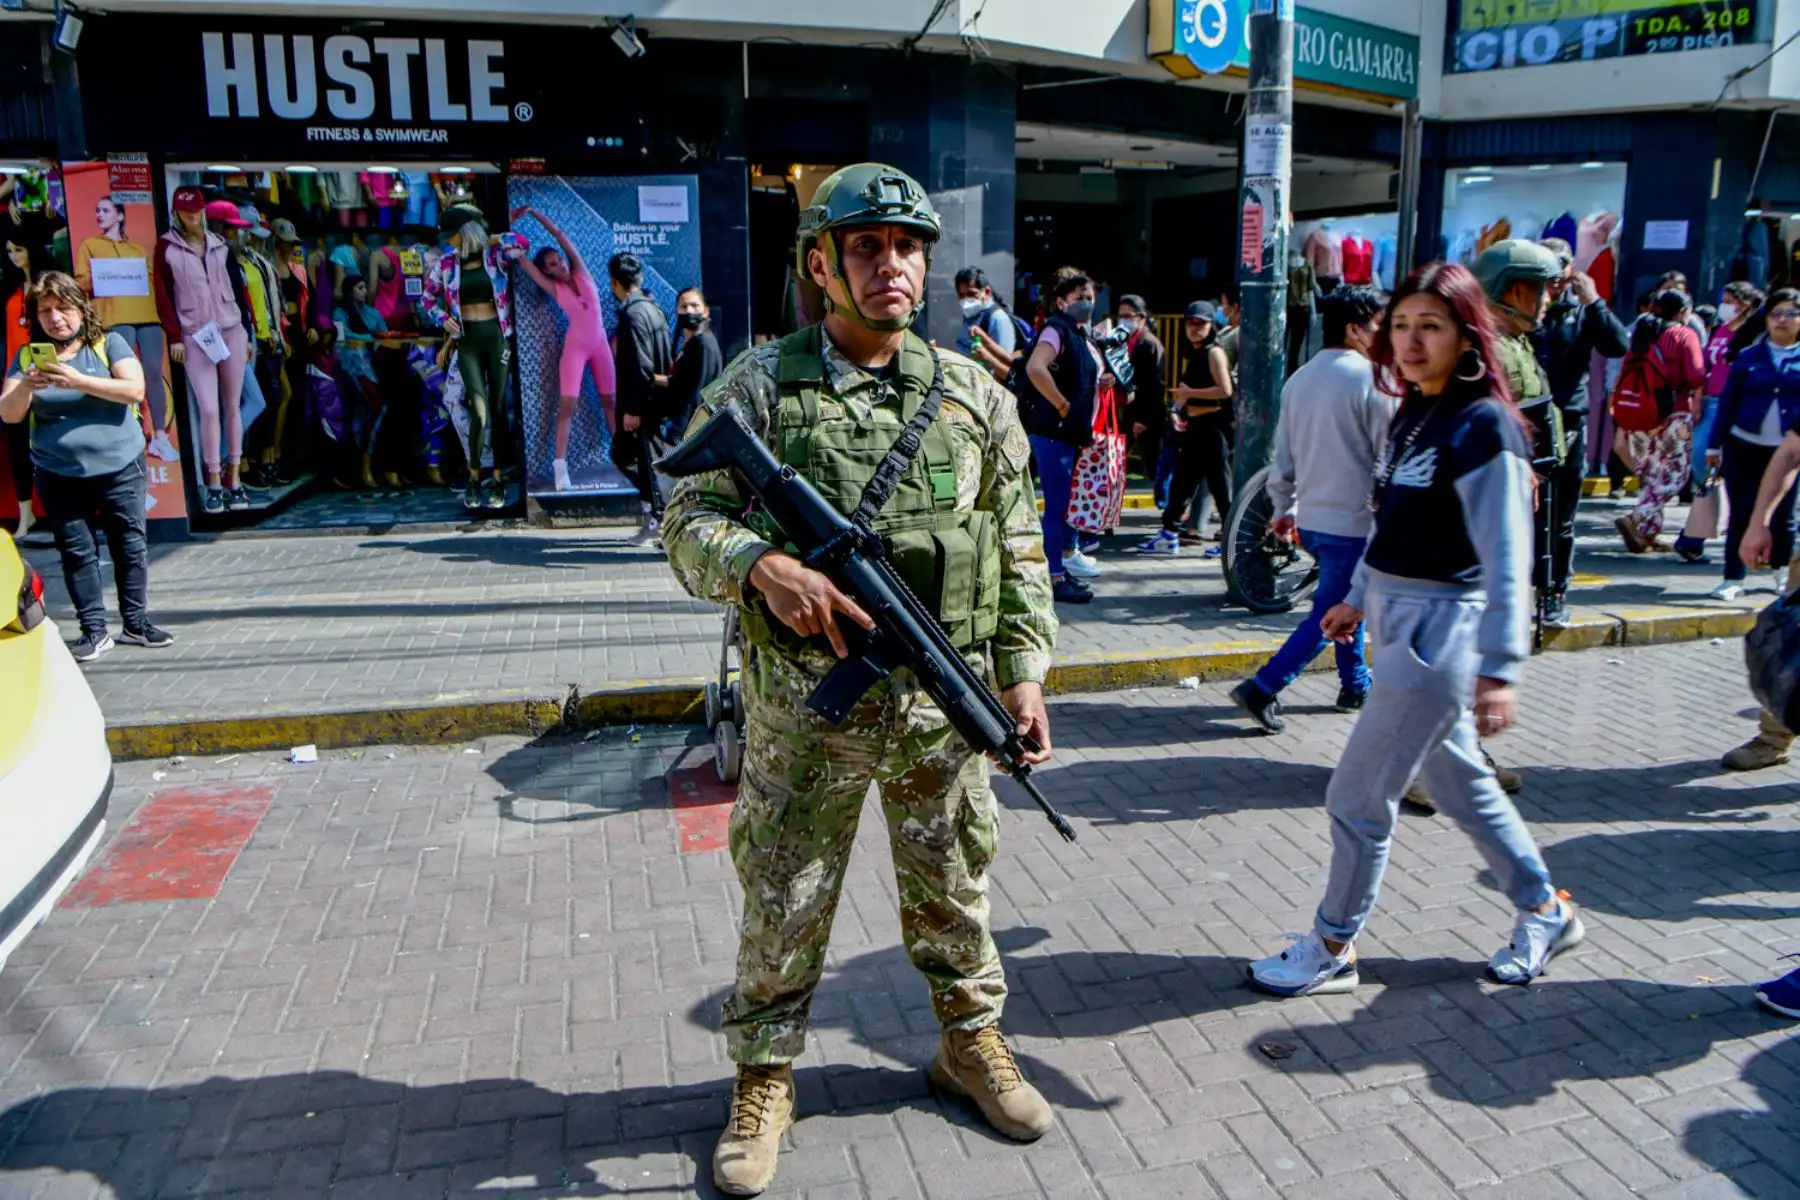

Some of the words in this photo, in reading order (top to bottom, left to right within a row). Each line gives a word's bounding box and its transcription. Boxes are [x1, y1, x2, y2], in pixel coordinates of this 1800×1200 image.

[1635, 15, 1691, 36] TDA.
[1702, 7, 1750, 30] 208
[1329, 31, 1415, 85] GAMARRA
[202, 32, 509, 121] HUSTLE
[306, 126, 361, 141] FITNESS
[363, 127, 373, 141] &
[375, 127, 449, 142] SWIMWEAR
[613, 222, 647, 232] Believe
[648, 223, 657, 232] in
[659, 223, 681, 235] your
